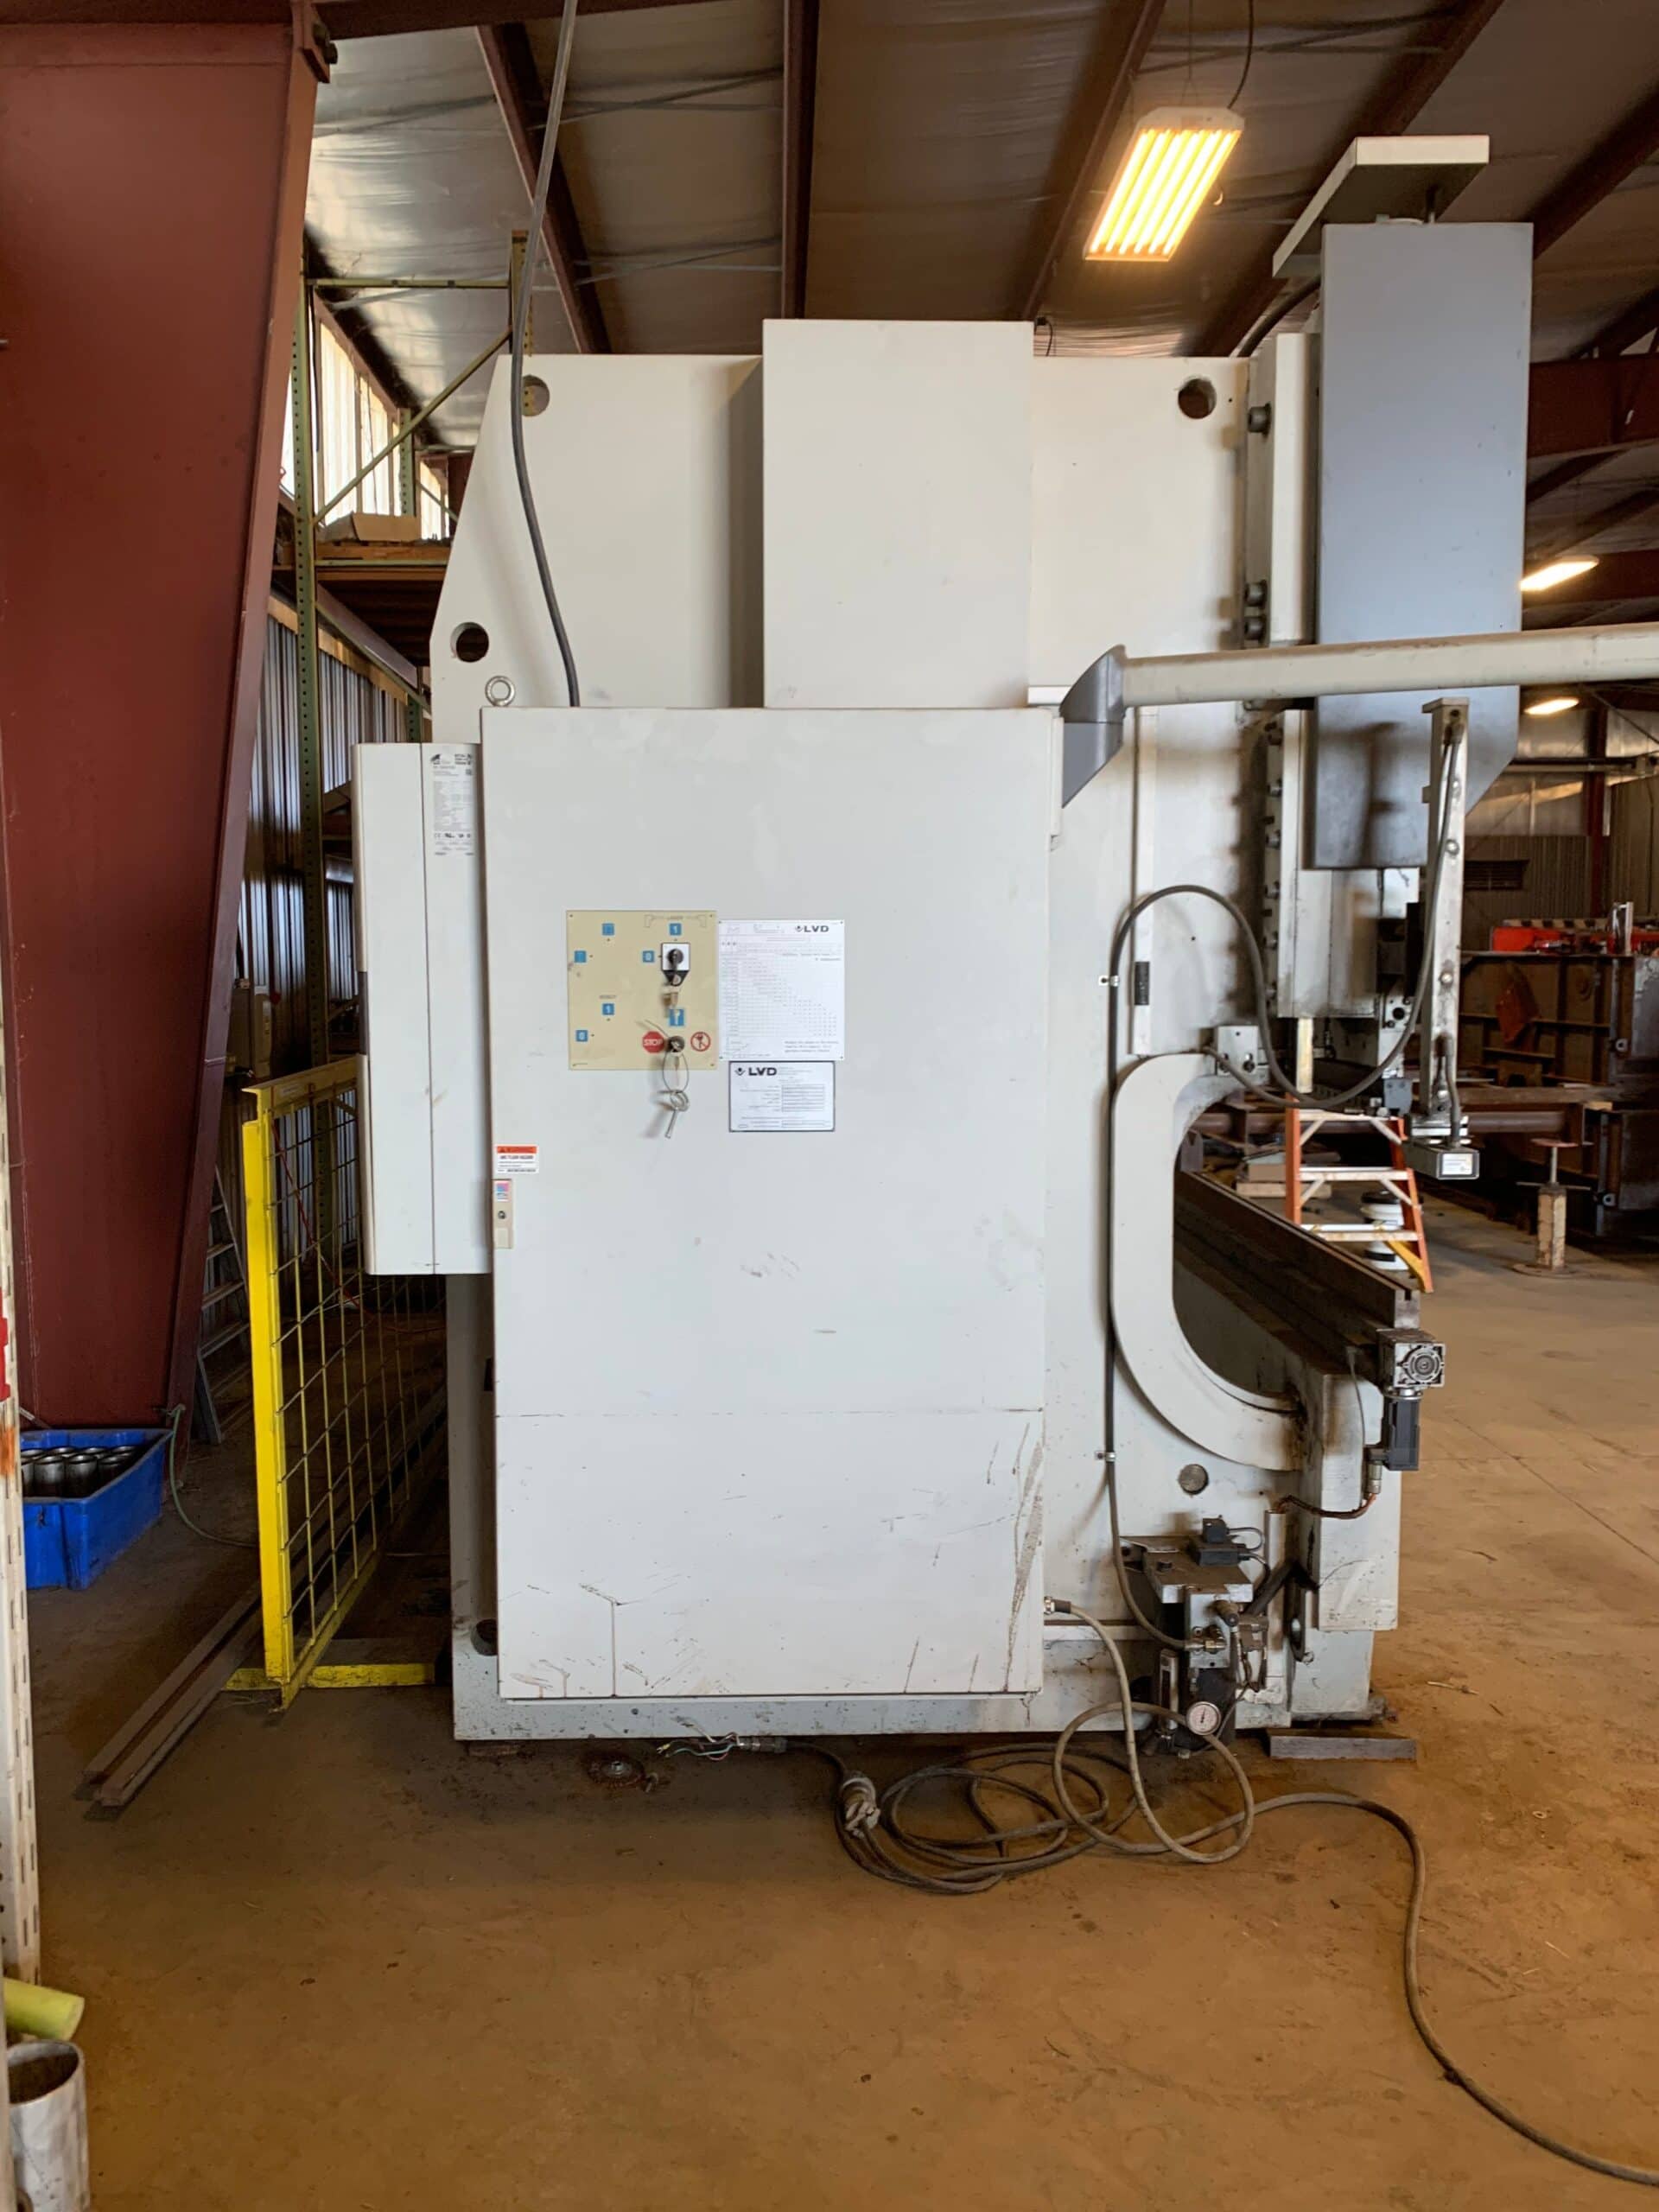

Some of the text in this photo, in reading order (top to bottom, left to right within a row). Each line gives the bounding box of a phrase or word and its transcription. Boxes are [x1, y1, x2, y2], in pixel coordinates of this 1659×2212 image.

[804, 925, 830, 933] LVD
[643, 1038, 664, 1046] STOP
[748, 1066, 778, 1077] LVD
